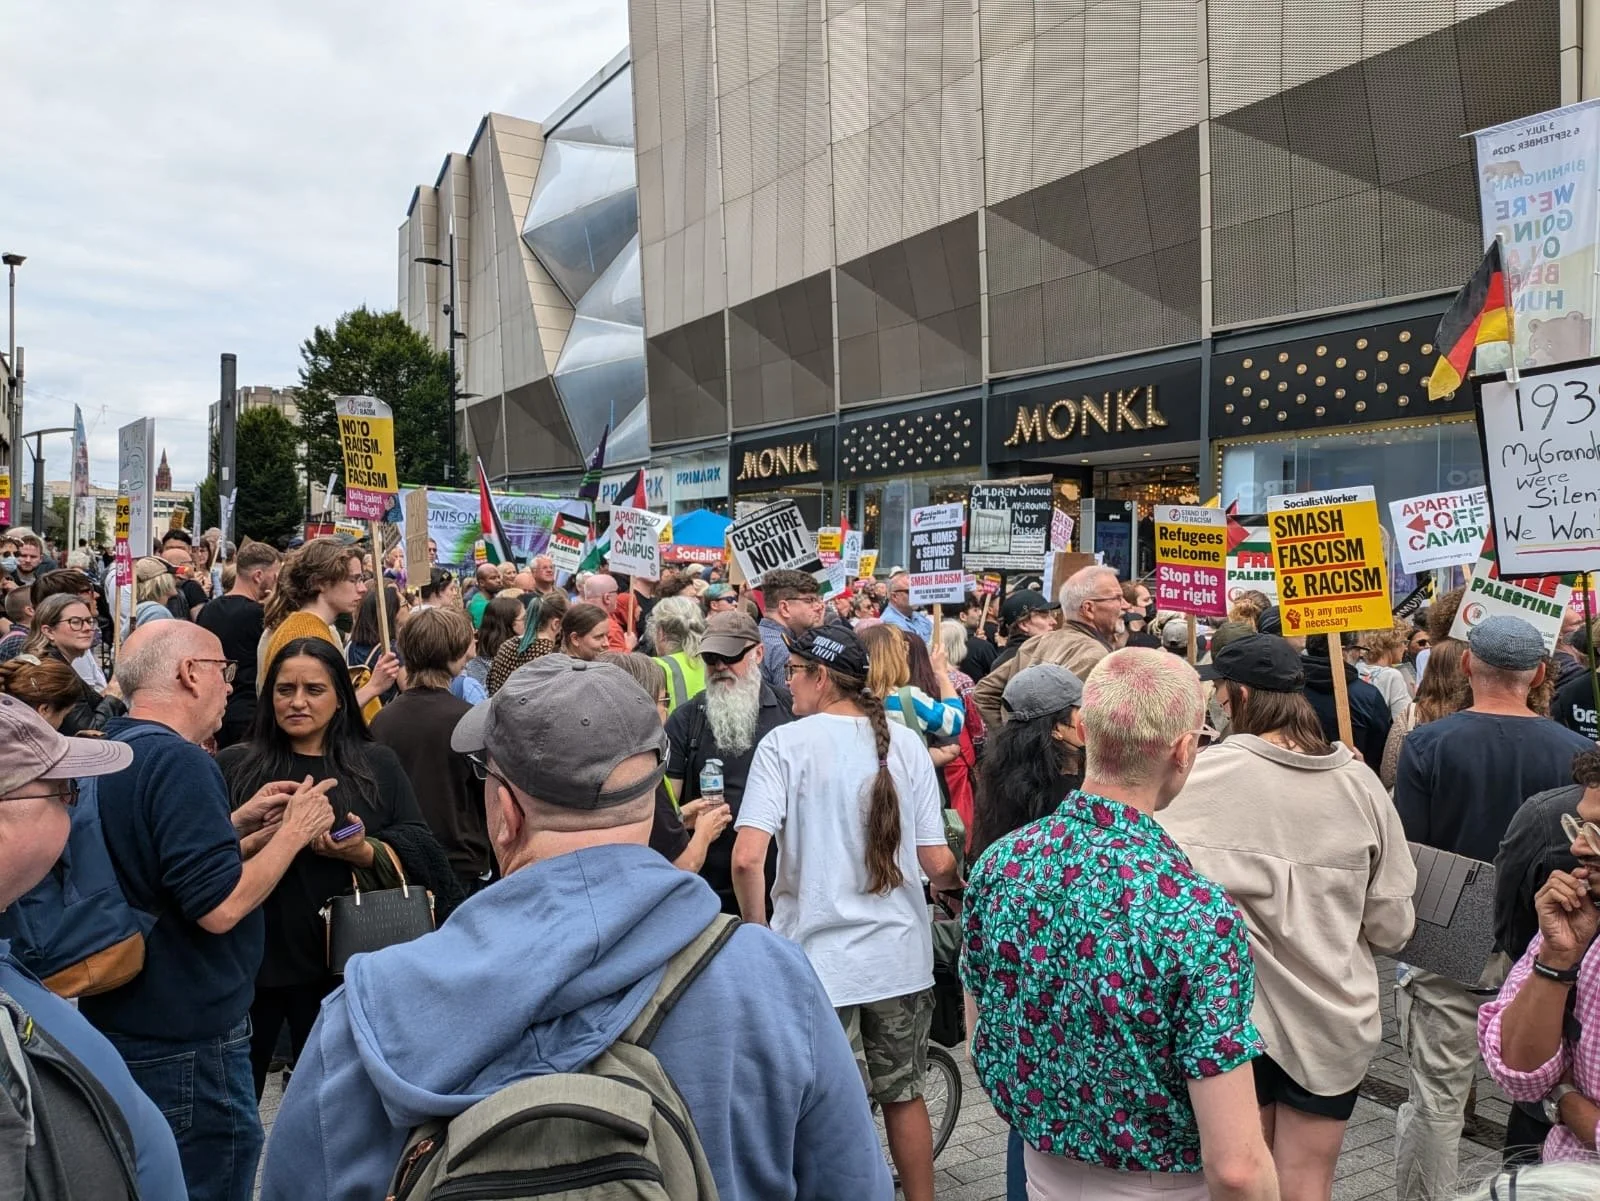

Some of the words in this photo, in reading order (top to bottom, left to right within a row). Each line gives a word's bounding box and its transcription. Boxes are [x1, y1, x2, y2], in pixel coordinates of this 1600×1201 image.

[1003, 384, 1168, 446] MONKI
[1515, 380, 1600, 432] 193
[342, 419, 356, 434] NO
[346, 452, 360, 468] NO
[676, 466, 721, 486] PRIMARK
[1190, 516, 1212, 524] RACISM
[1274, 509, 1344, 538] SMASH
[1434, 506, 1484, 528] OFF
[1504, 514, 1536, 542] We
[1550, 510, 1600, 540] Won'
[627, 526, 648, 542] OFF
[732, 508, 802, 552] CEASEFIRE
[932, 530, 958, 544] HOMES
[1160, 526, 1224, 546] Refugees
[614, 540, 655, 560] CAMPUS
[676, 548, 722, 560] Socialist
[922, 544, 954, 558] SERVICES
[1160, 545, 1220, 562] welcome
[1278, 538, 1364, 568] FASCISM
[920, 560, 934, 572] FOR
[934, 558, 950, 570] ALL!
[910, 575, 932, 586] SMASH
[934, 573, 962, 585] RACISM
[1160, 566, 1190, 586] Stop
[1194, 570, 1218, 586] the
[1228, 570, 1276, 581] PALEST
[1282, 576, 1298, 598] &
[1304, 567, 1382, 597] RACISM
[1160, 584, 1180, 600] far
[1183, 587, 1216, 606] right
[1470, 577, 1564, 618] PALESTINE
[1304, 607, 1315, 619] By
[1318, 608, 1332, 618] any
[1335, 604, 1362, 615] means
[1305, 616, 1348, 628] necessary
